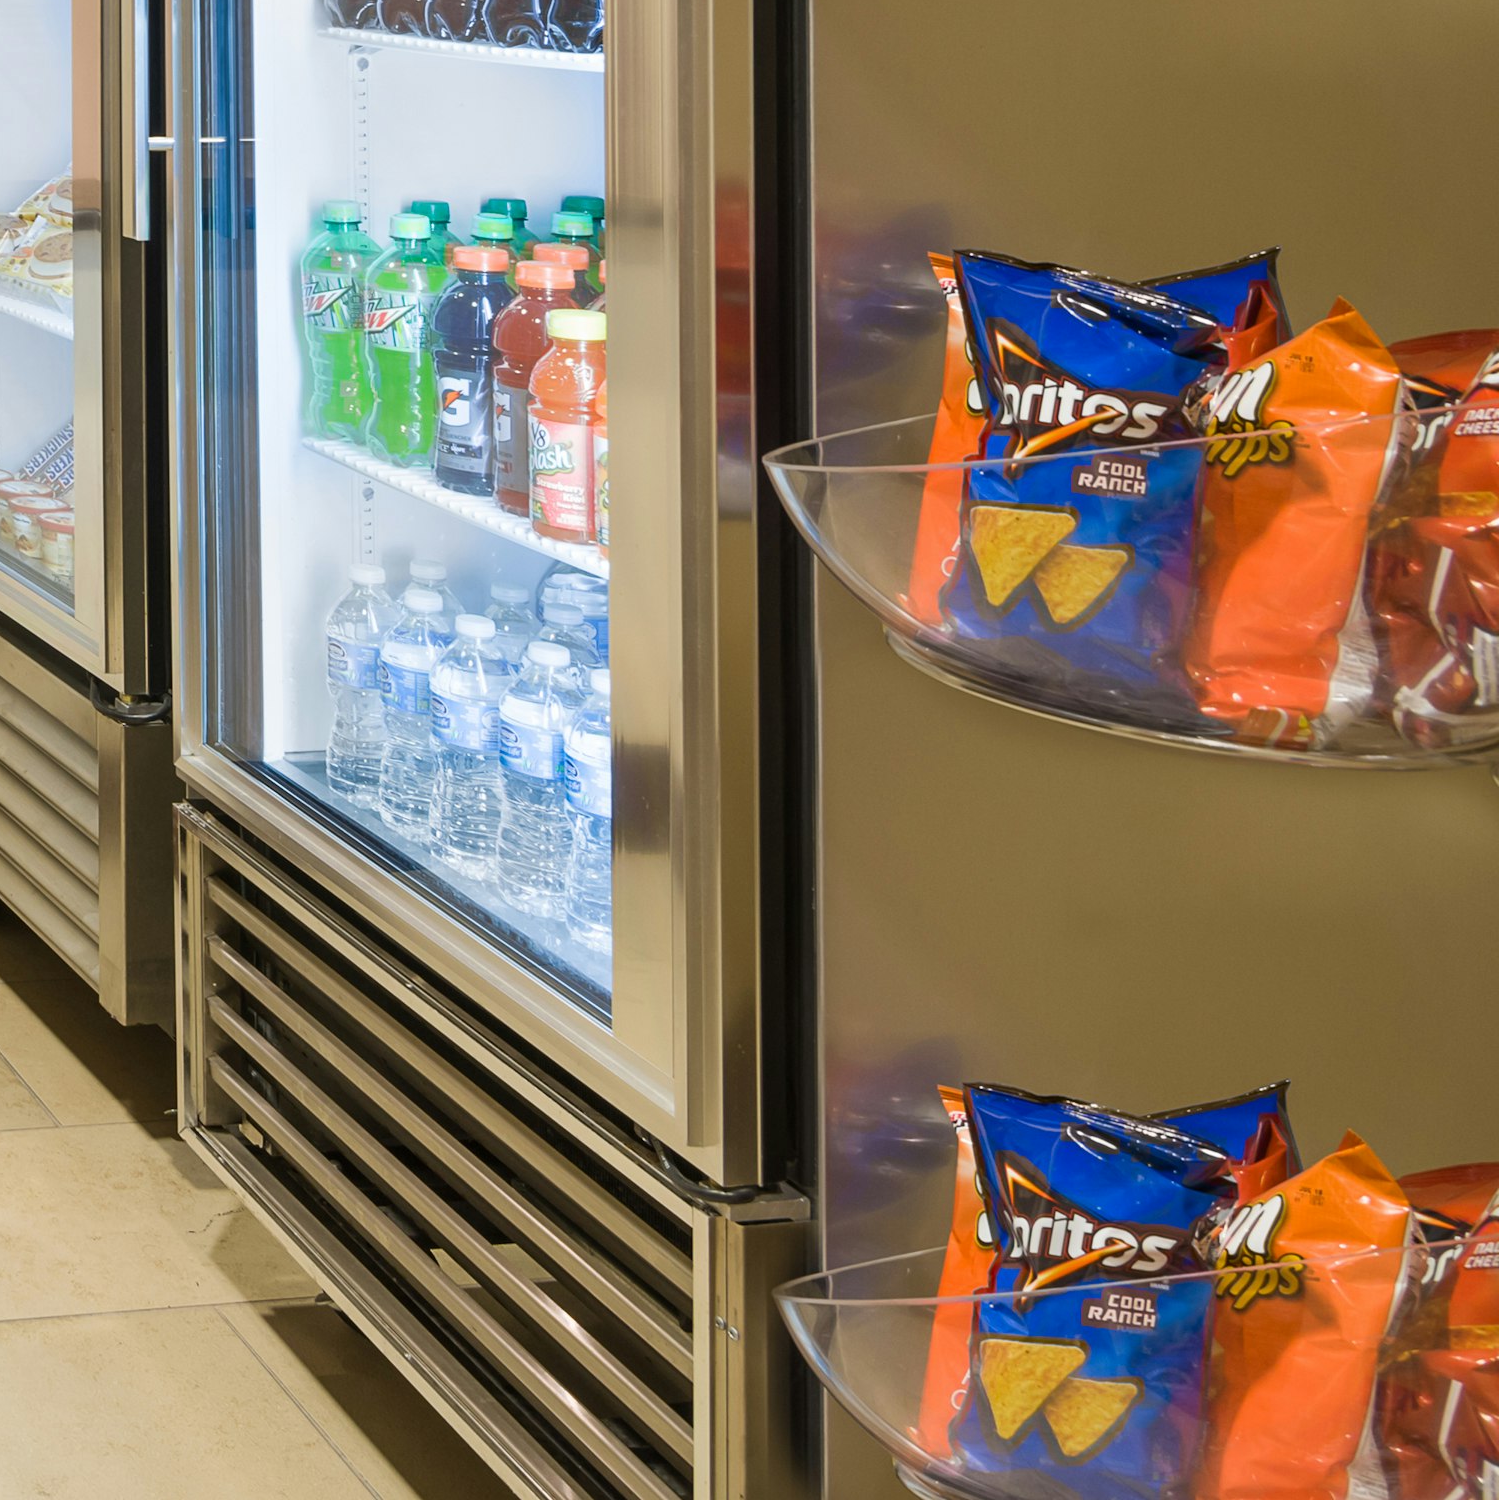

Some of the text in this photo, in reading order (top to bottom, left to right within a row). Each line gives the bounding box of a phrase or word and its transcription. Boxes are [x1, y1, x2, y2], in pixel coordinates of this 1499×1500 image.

[531, 421, 548, 448] V8
[24, 422, 74, 477] SNICKERS
[1098, 461, 1145, 480] COOL
[1077, 474, 1147, 495] RANCH
[1107, 1294, 1155, 1313] COOL
[1087, 1306, 1157, 1328] RANCH
